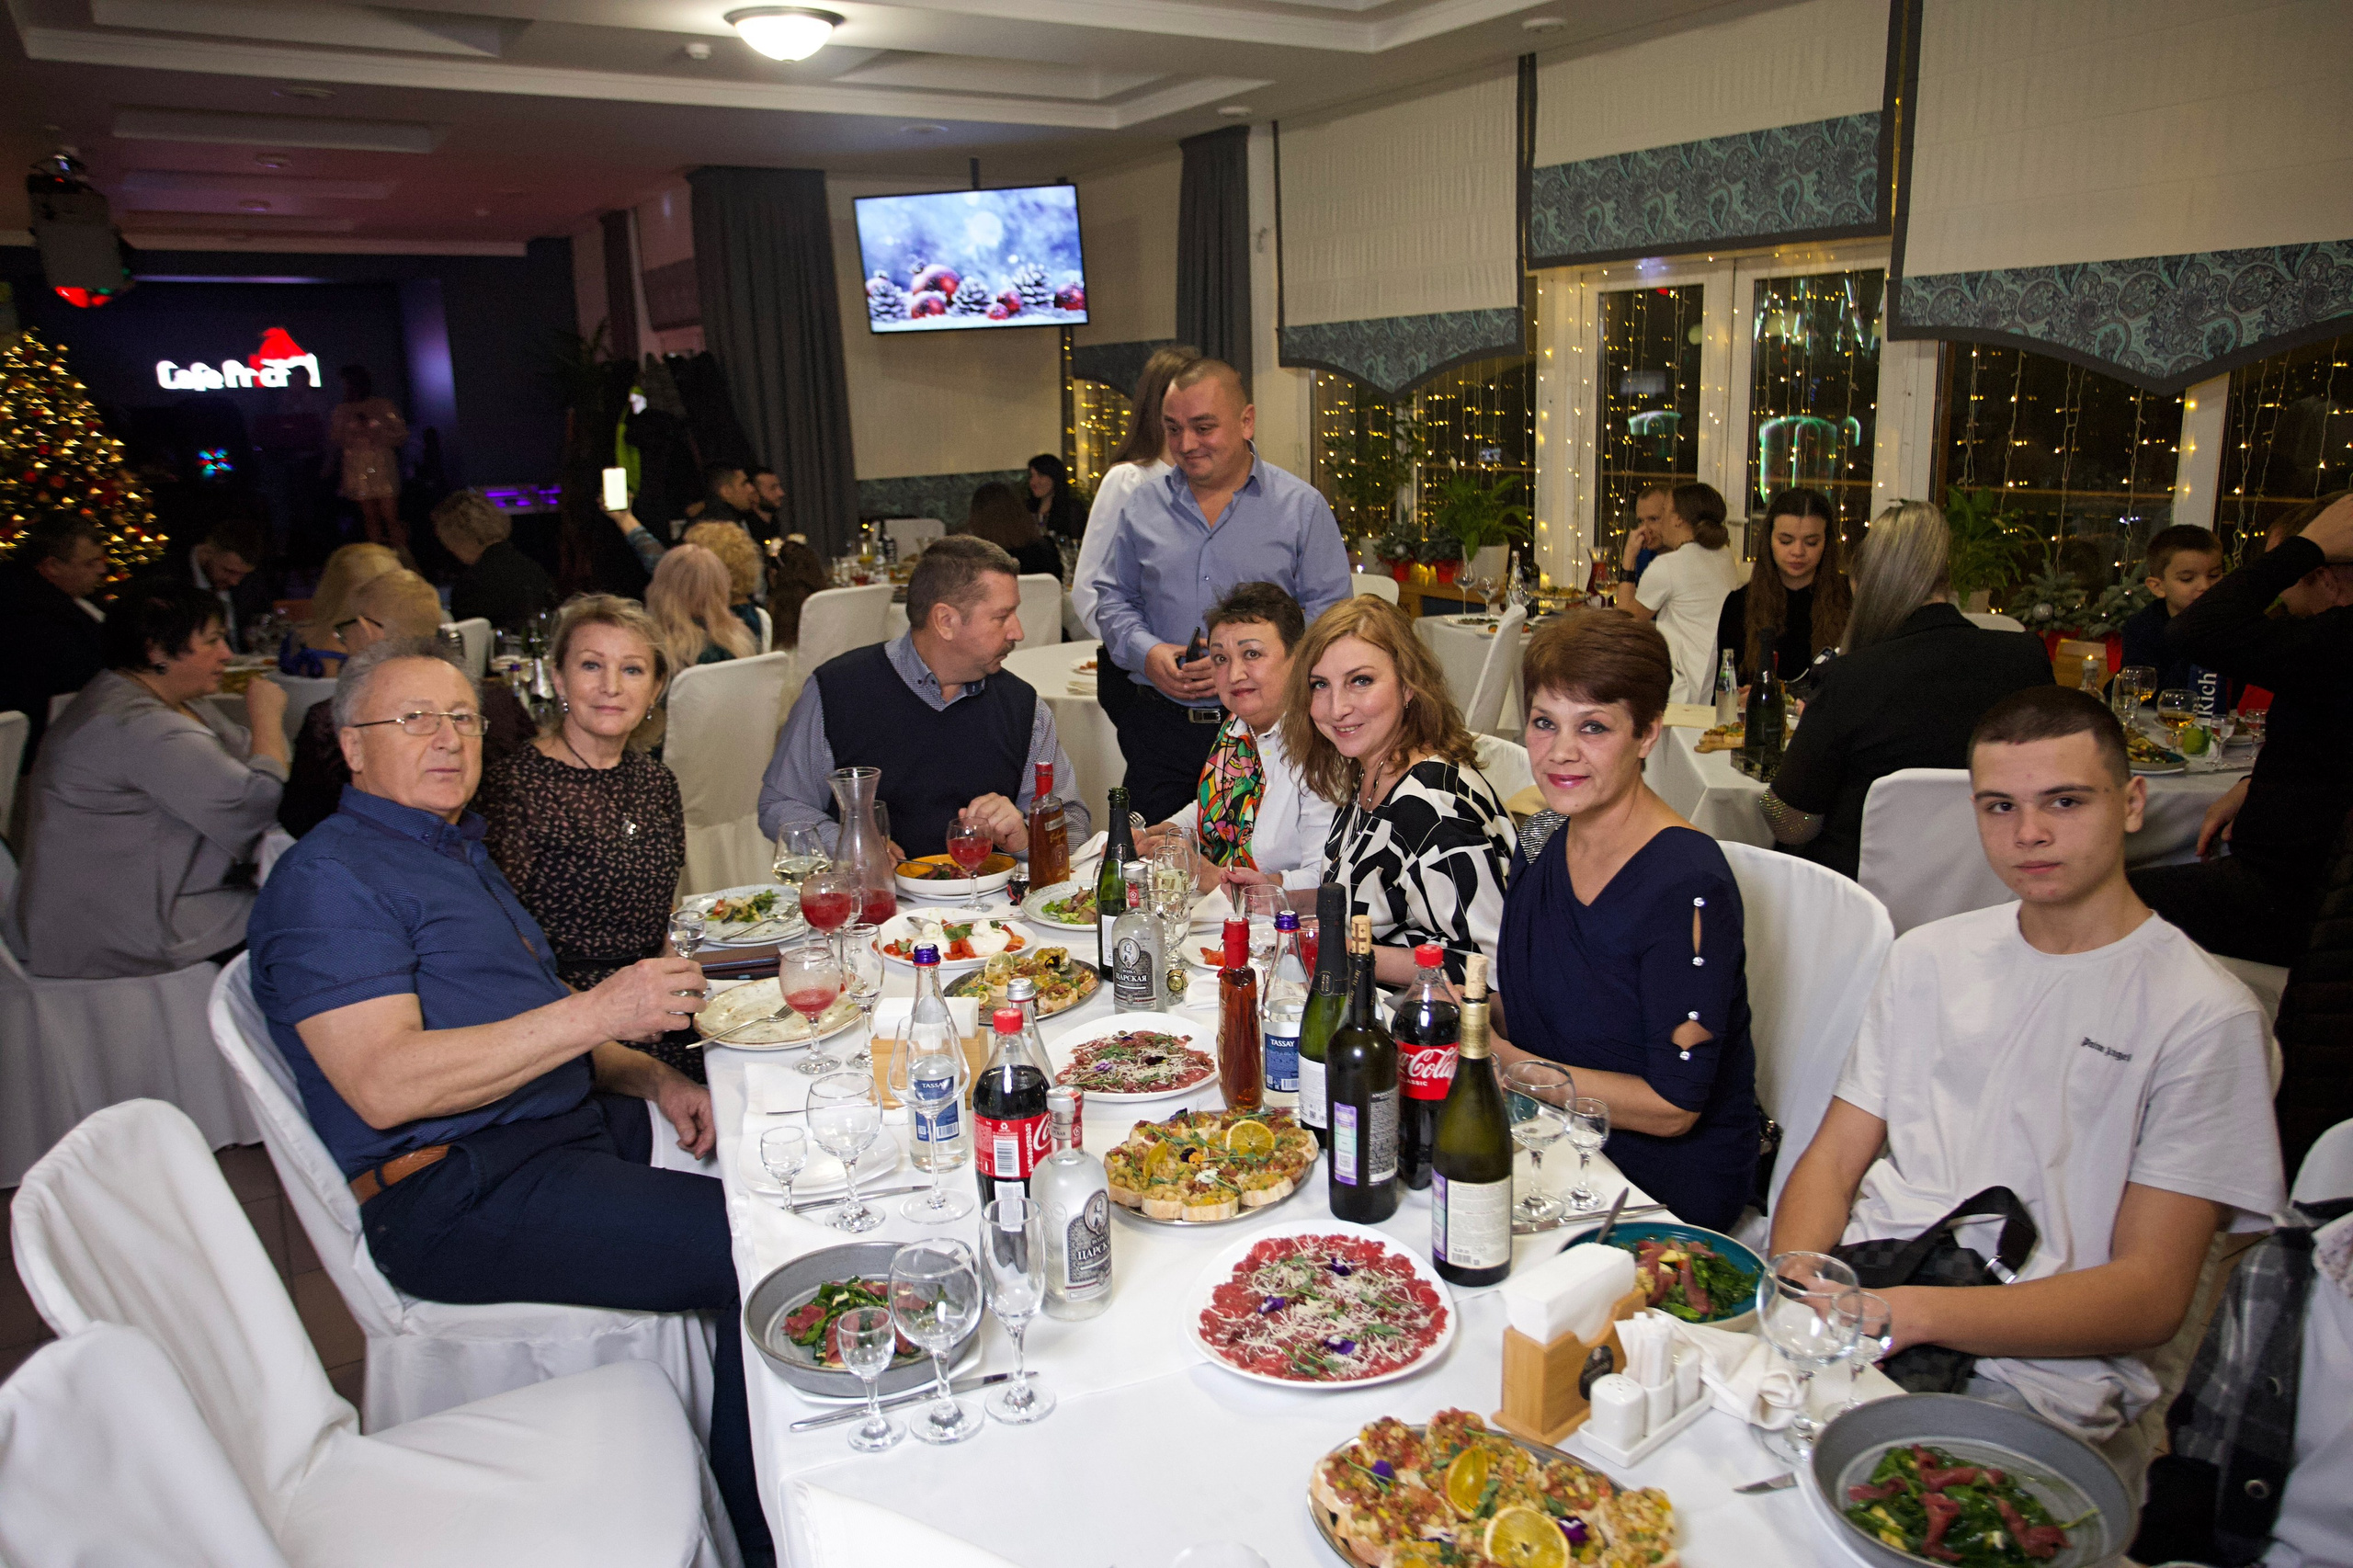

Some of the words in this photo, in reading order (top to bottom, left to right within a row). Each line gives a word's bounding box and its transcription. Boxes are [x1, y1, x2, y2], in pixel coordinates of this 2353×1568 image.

[2198, 672, 2218, 715] Rich
[1116, 972, 1147, 983] ЦАРСКАЯ
[1270, 1039, 1295, 1048] TASSAY
